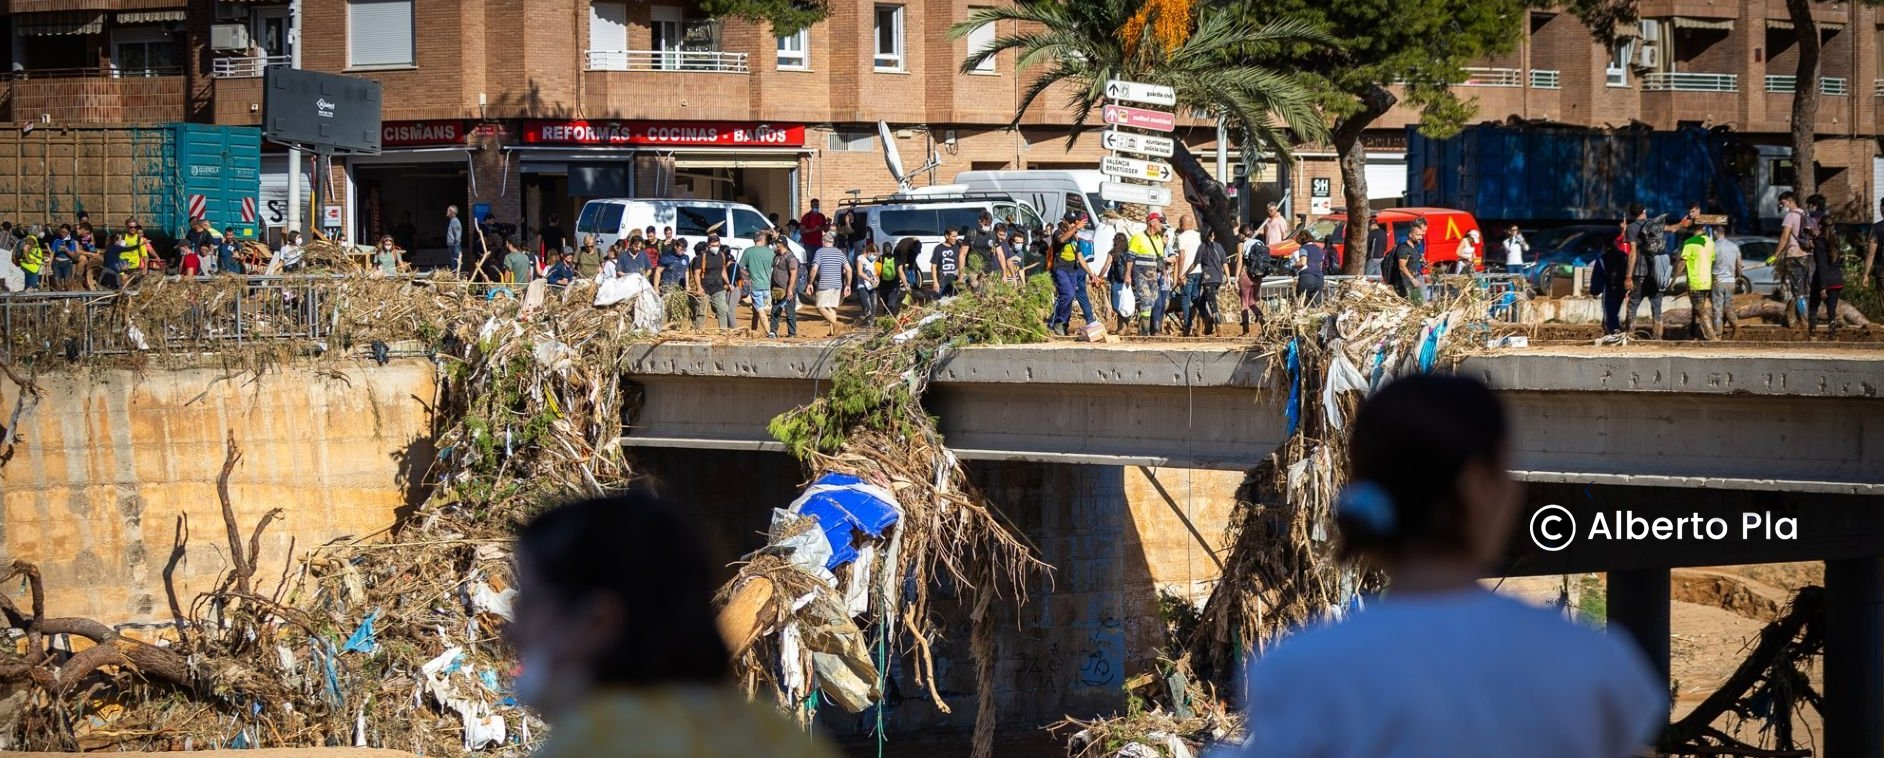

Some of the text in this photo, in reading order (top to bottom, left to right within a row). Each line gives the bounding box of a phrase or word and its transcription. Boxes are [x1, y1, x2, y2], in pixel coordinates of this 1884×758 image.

[542, 126, 630, 141] REFORMAS
[647, 127, 718, 142] COCINAS
[942, 249, 955, 276] 1973
